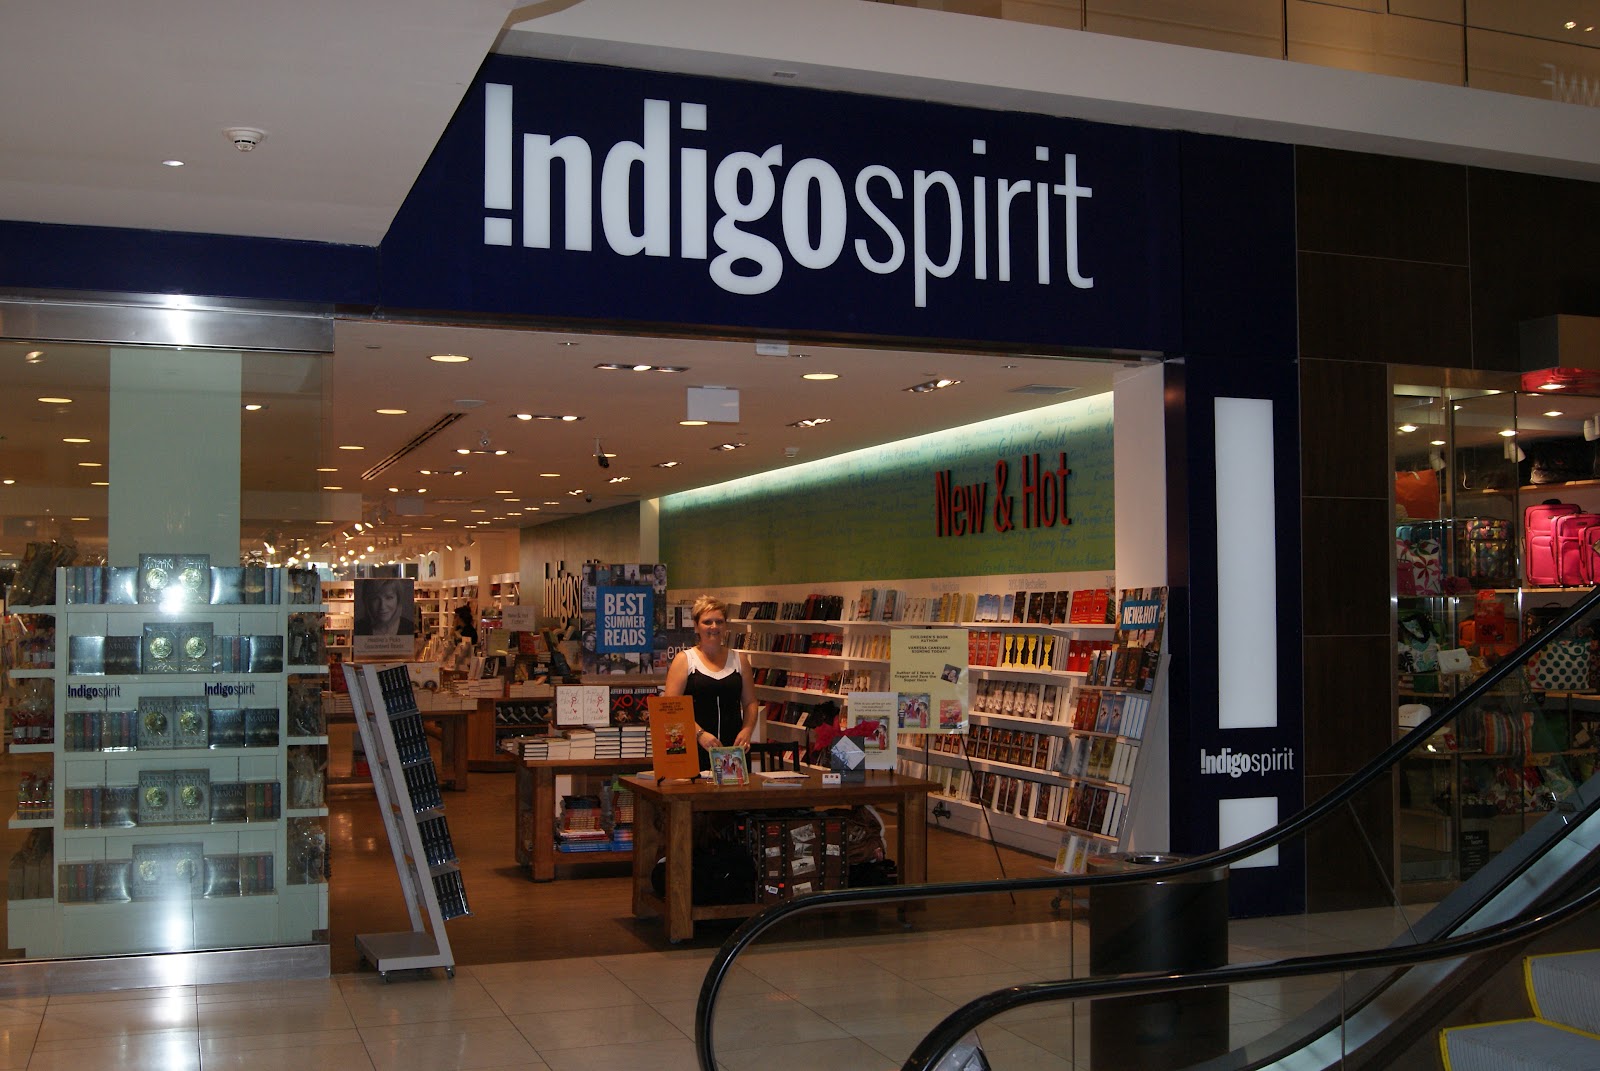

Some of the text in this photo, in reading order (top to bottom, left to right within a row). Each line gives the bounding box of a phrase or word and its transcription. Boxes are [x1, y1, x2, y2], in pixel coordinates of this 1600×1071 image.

[935, 452, 1073, 538] New & Hot
[604, 593, 647, 615] BEST
[604, 616, 645, 628] SUMMER
[604, 629, 646, 646] READS
